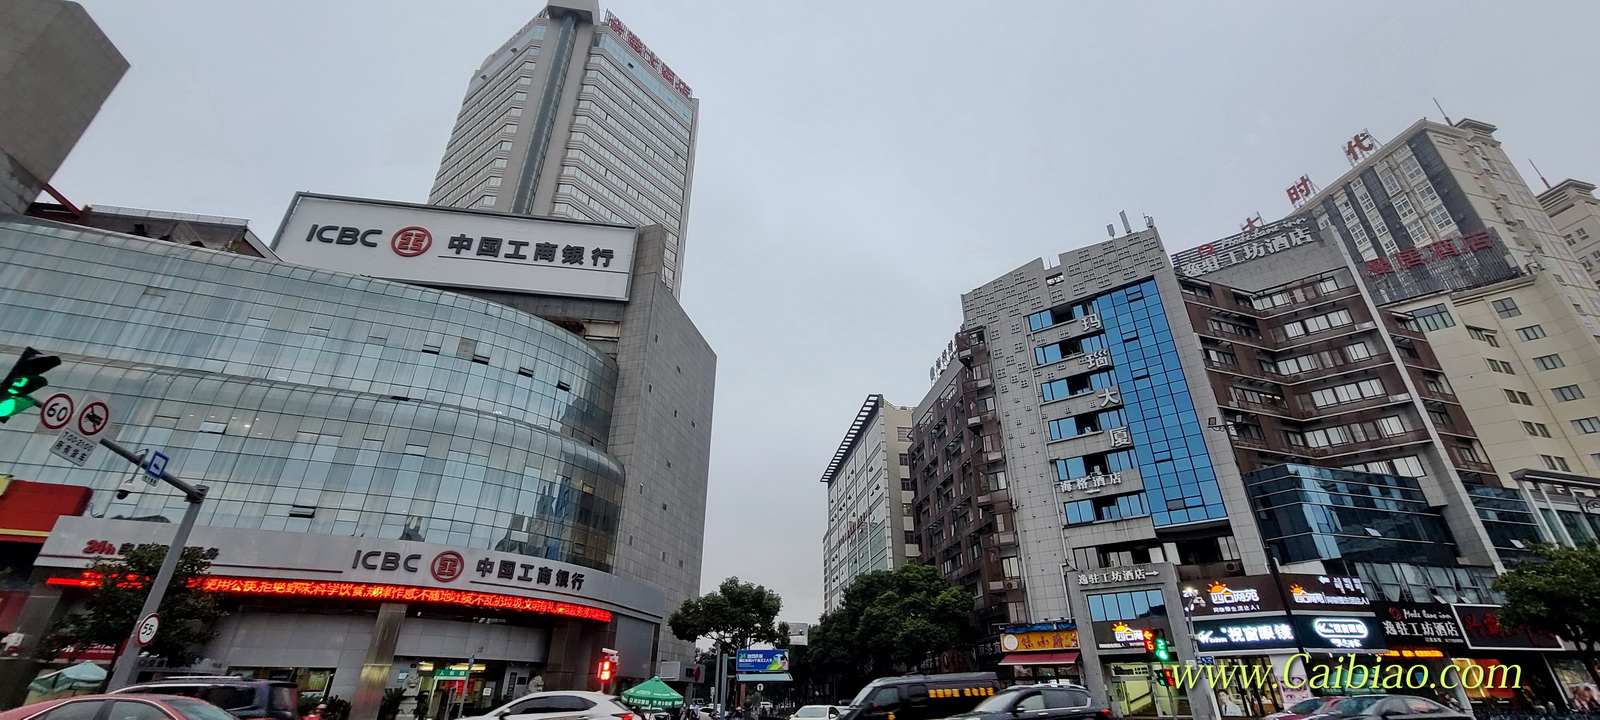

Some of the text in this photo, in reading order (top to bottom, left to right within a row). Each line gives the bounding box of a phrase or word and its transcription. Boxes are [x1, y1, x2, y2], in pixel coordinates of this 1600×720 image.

[306, 224, 382, 247] ICBC
[447, 233, 614, 267] 中国工商银行
[1081, 312, 1132, 448] 玛瑙大厦
[46, 402, 68, 422] 60
[1060, 472, 1122, 493] 海格酒店
[82, 540, 116, 555] 24h
[352, 549, 421, 573] ICBC
[476, 557, 585, 591] 中国工商银行
[1078, 568, 1146, 585] 逸驻工坊酒店
[1228, 623, 1294, 643] 视窗眼镜
[1381, 620, 1460, 637] 逸驻工坊酒店
